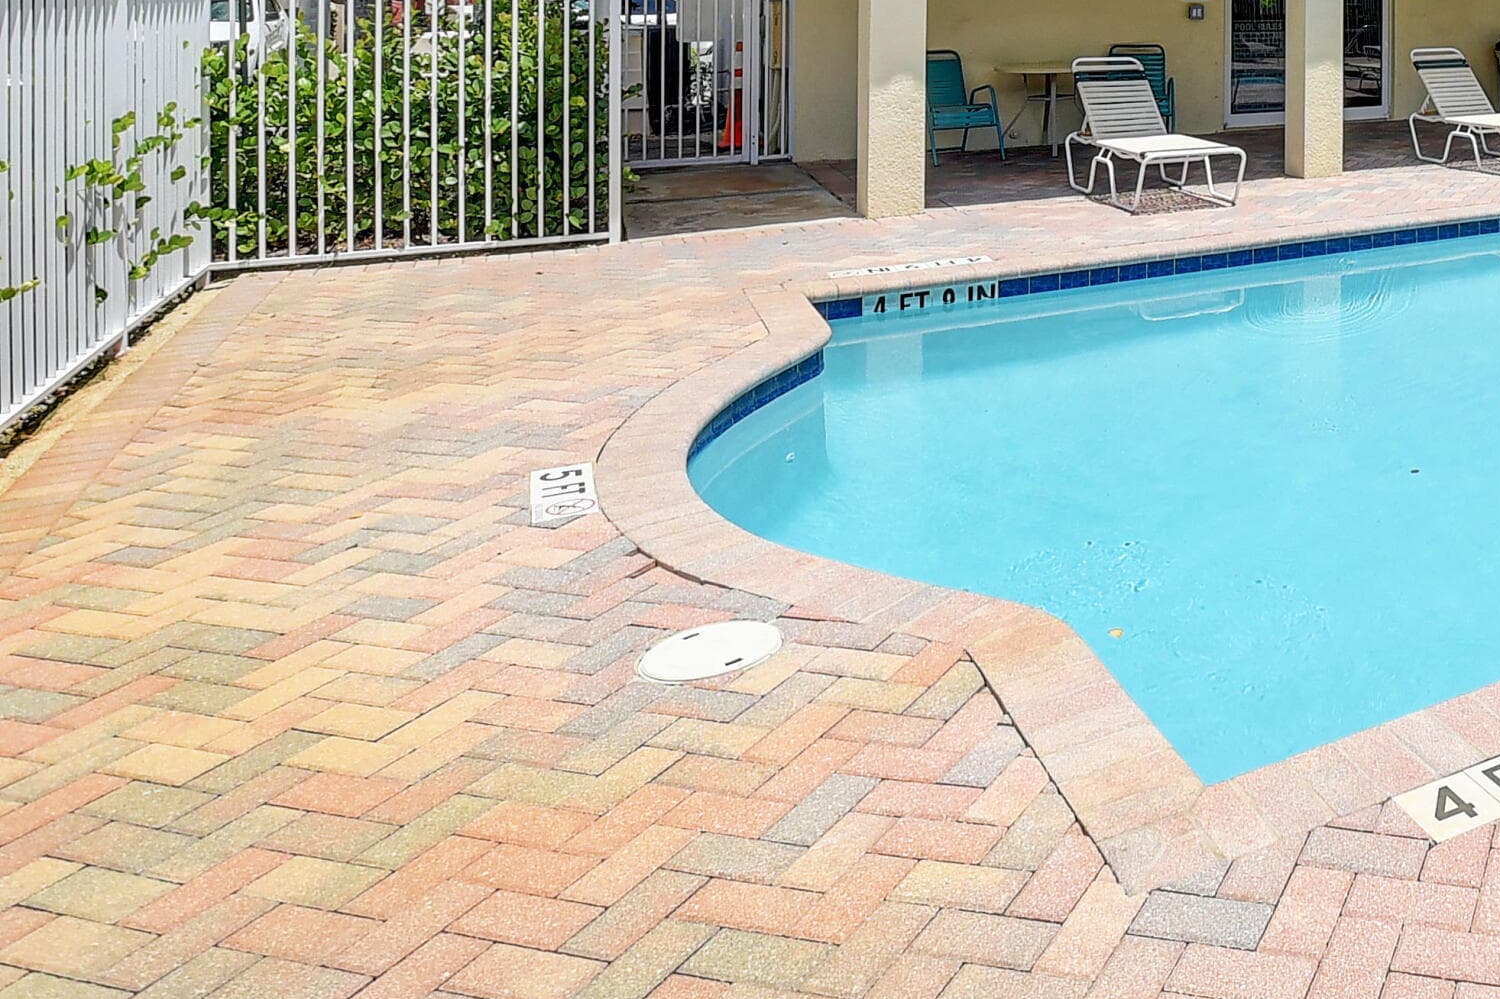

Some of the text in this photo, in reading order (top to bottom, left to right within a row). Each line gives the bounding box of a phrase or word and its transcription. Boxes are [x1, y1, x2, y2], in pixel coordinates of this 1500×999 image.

[1234, 23, 1255, 31] POOL
[873, 295, 886, 313] 4
[900, 290, 930, 311] FT
[968, 282, 996, 301] IN
[540, 469, 586, 498] 5 FT
[1433, 784, 1479, 822] 4
